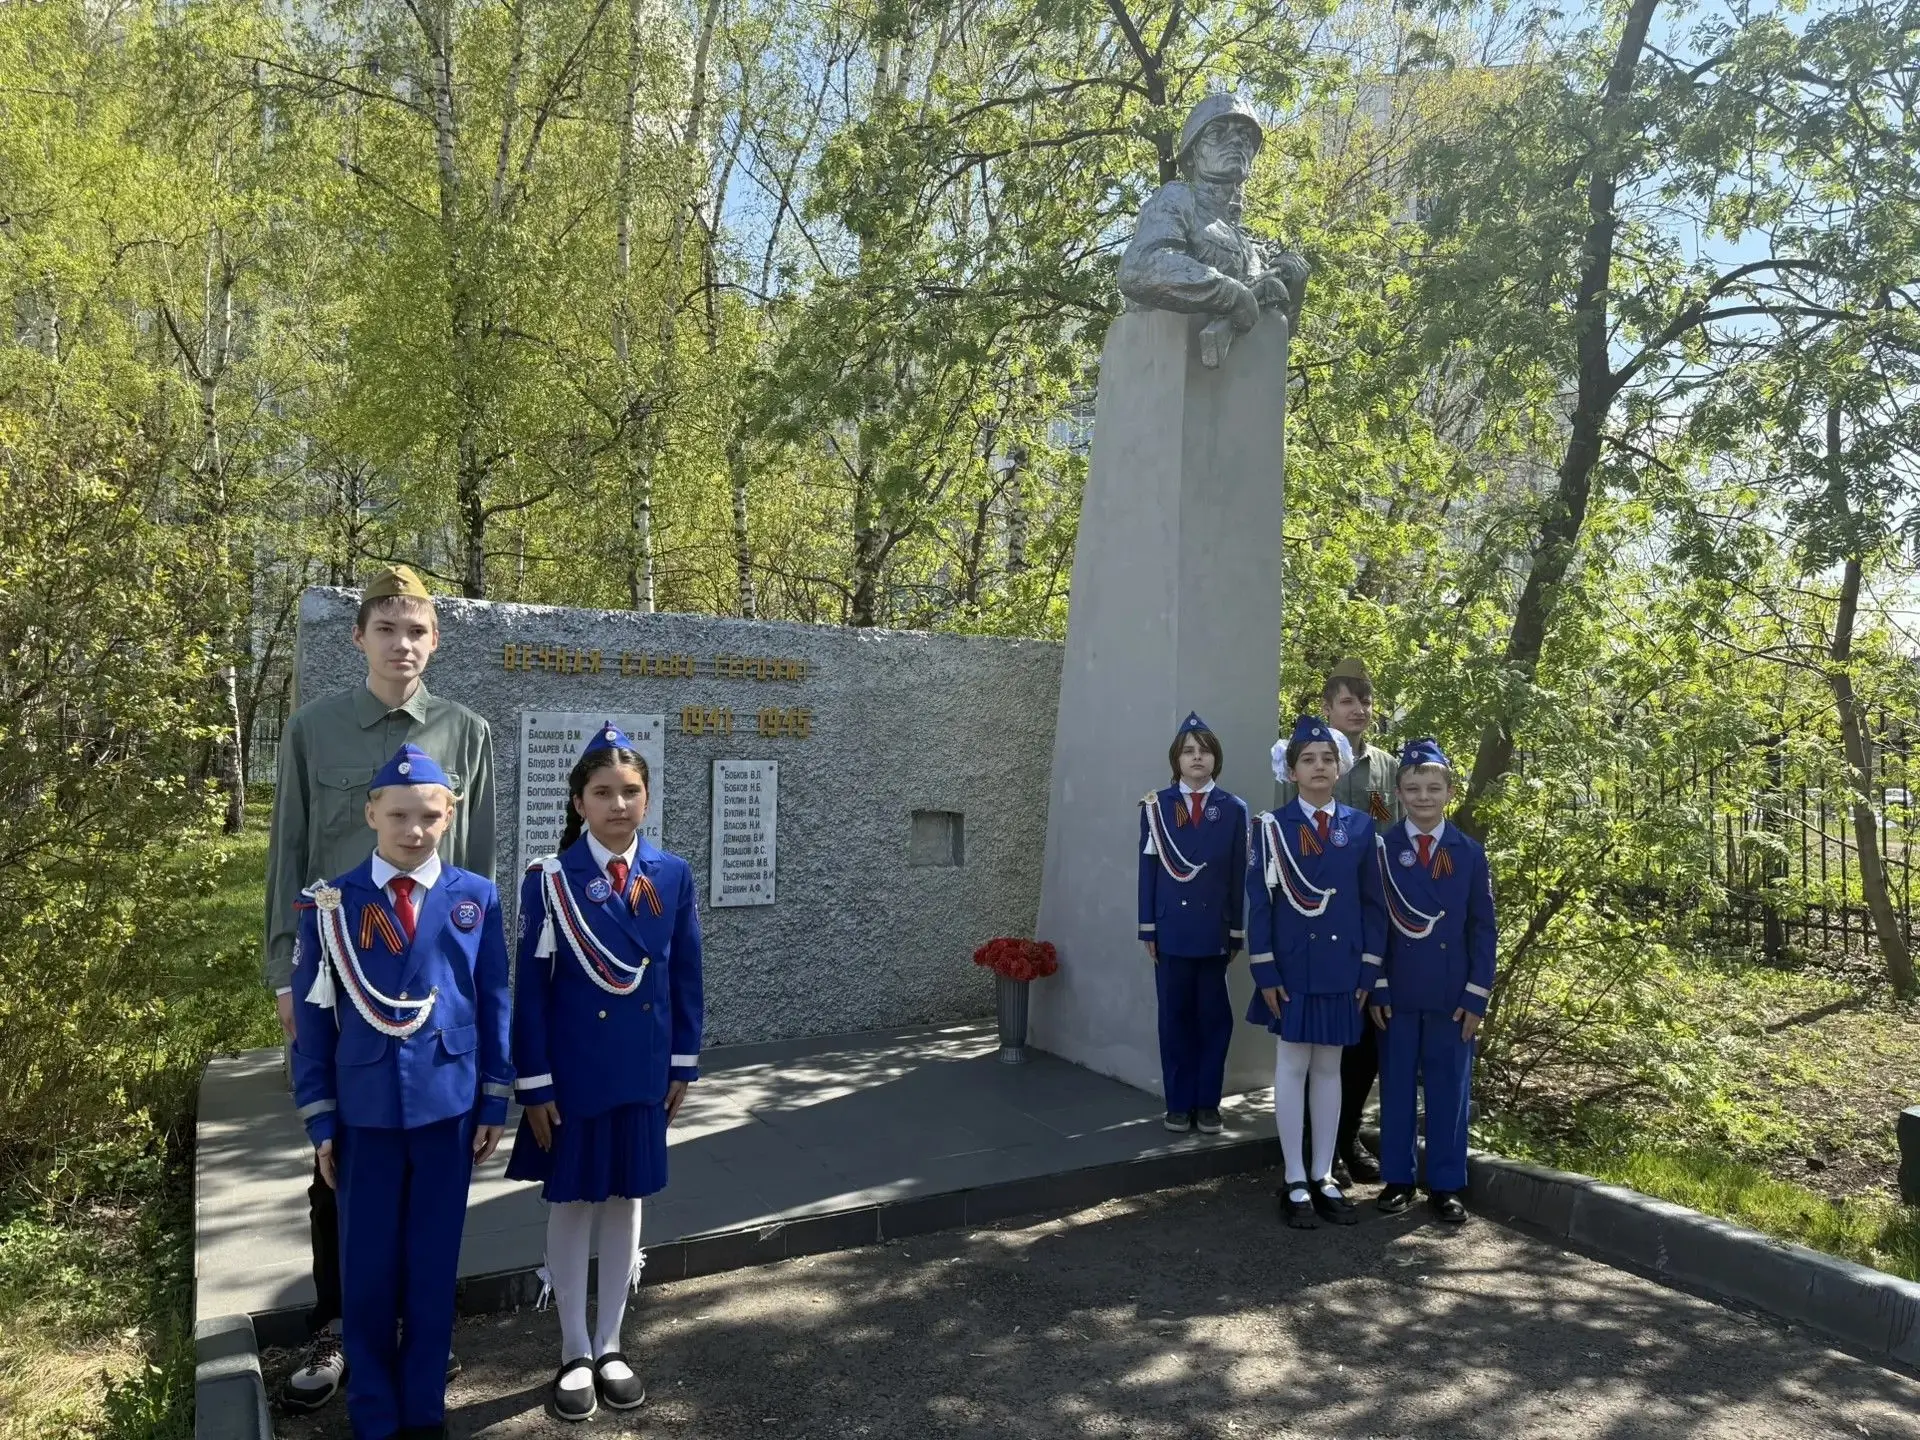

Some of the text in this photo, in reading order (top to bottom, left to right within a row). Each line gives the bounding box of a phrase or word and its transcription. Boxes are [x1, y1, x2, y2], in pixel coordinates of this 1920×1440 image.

[504, 643, 601, 674] ВЕЧНАЯ
[621, 650, 696, 678] СЛАВА
[681, 704, 812, 738] 1941 1945
[529, 730, 564, 740] БАСКАКОВ
[528, 744, 560, 754] БАХАРЕВ
[528, 758, 556, 769] БЛУДОВ
[528, 772, 556, 782] БОБКОВ
[725, 770, 748, 779] БОБКОВ
[725, 783, 748, 792] БОБКОВ
[725, 796, 747, 805] БУКЛИН
[527, 802, 554, 811] БУКЛИН
[527, 816, 556, 826] ВЫДРИН
[527, 830, 549, 840] ГОЛОВ
[526, 845, 556, 856] ГОРДЕЕВ
[723, 848, 752, 856] ЛЕВАШОВ
